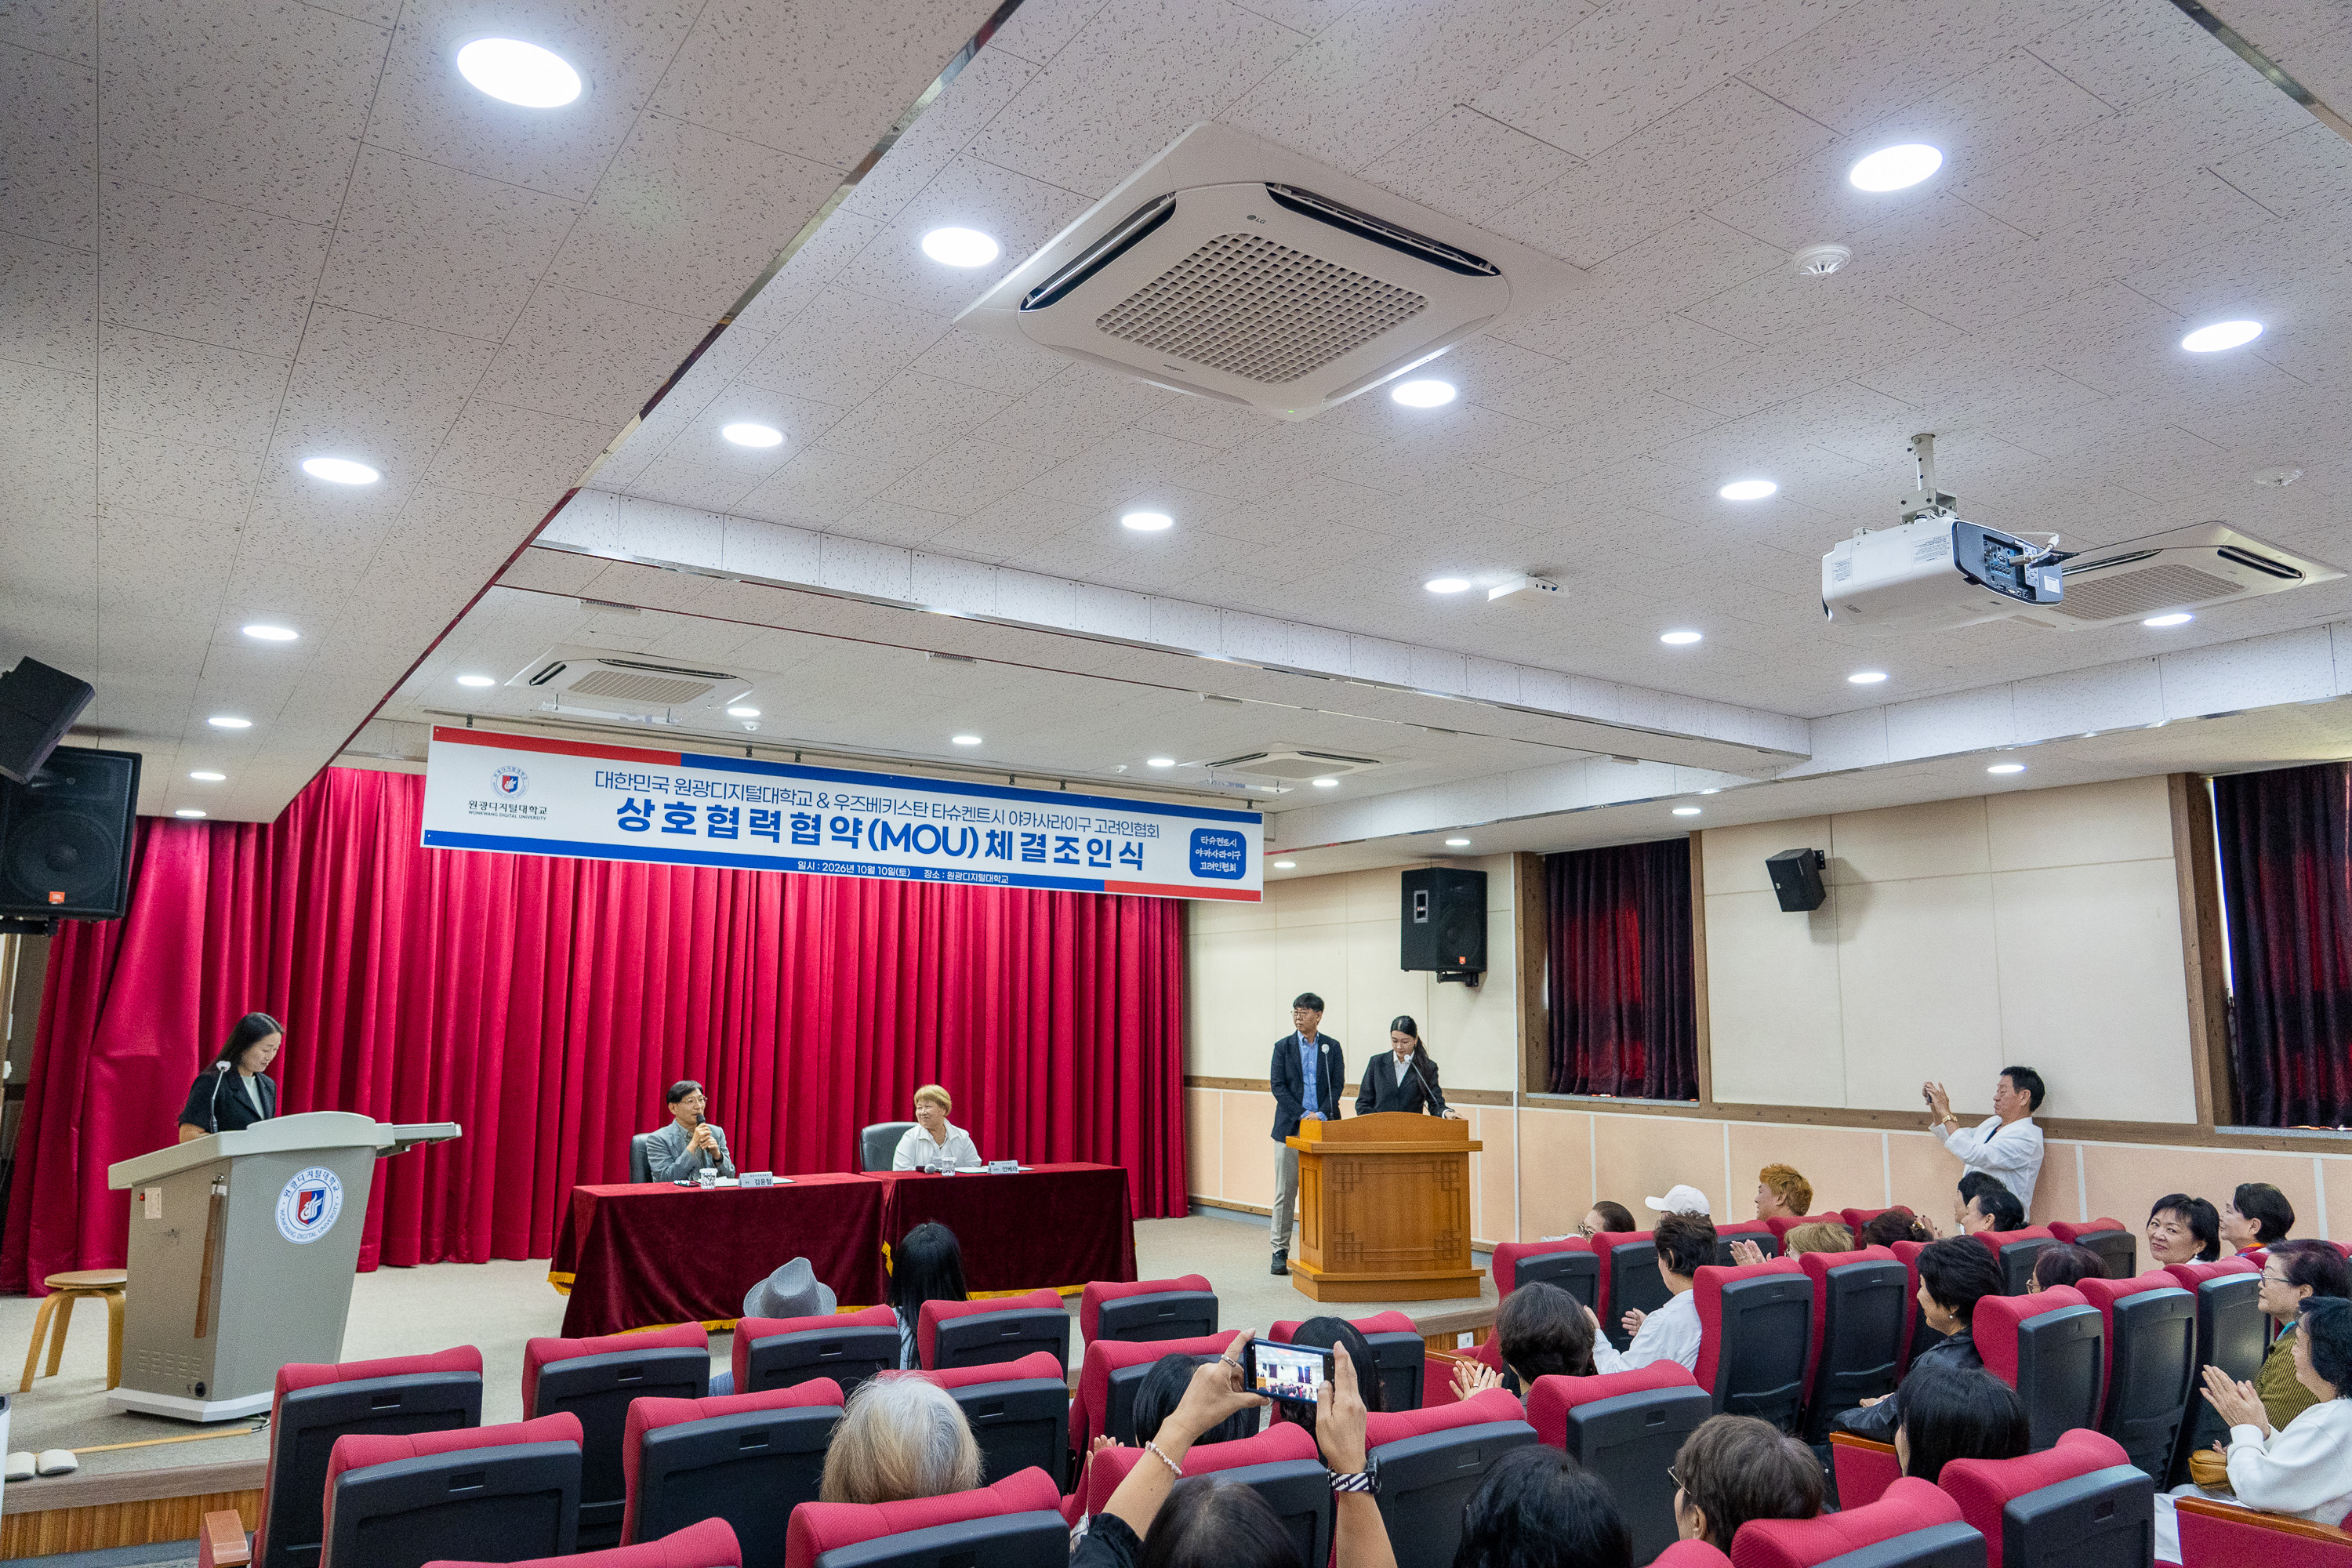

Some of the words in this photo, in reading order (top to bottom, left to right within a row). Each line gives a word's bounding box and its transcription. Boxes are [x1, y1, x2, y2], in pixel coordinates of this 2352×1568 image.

[468, 800, 547, 815] 원광디지털대학교
[594, 771, 670, 794] 대한민국
[673, 778, 813, 808] 원광디지털대학교
[816, 792, 830, 809] &
[833, 793, 929, 818] 우즈베키스탄
[931, 803, 1005, 826] 타슈켄트시
[1008, 811, 1092, 833] 야카사라이구
[1094, 818, 1160, 839] 고려인협회
[1200, 835, 1237, 848] 타슈켄트시
[1195, 848, 1242, 861] 야카사라이구
[797, 860, 815, 871] 일시
[822, 862, 855, 873] 2026년
[857, 865, 876, 876] 10월
[877, 866, 912, 878] 10일(토)
[924, 869, 941, 880] 장소
[946, 870, 1010, 884] 원광디지털대학교
[1200, 861, 1236, 873] 고려인협회
[283, 1170, 340, 1198] 원광디지털대학교
[296, 1231, 318, 1240] DIGITAL
[317, 1202, 339, 1234] UNIVERSITY
